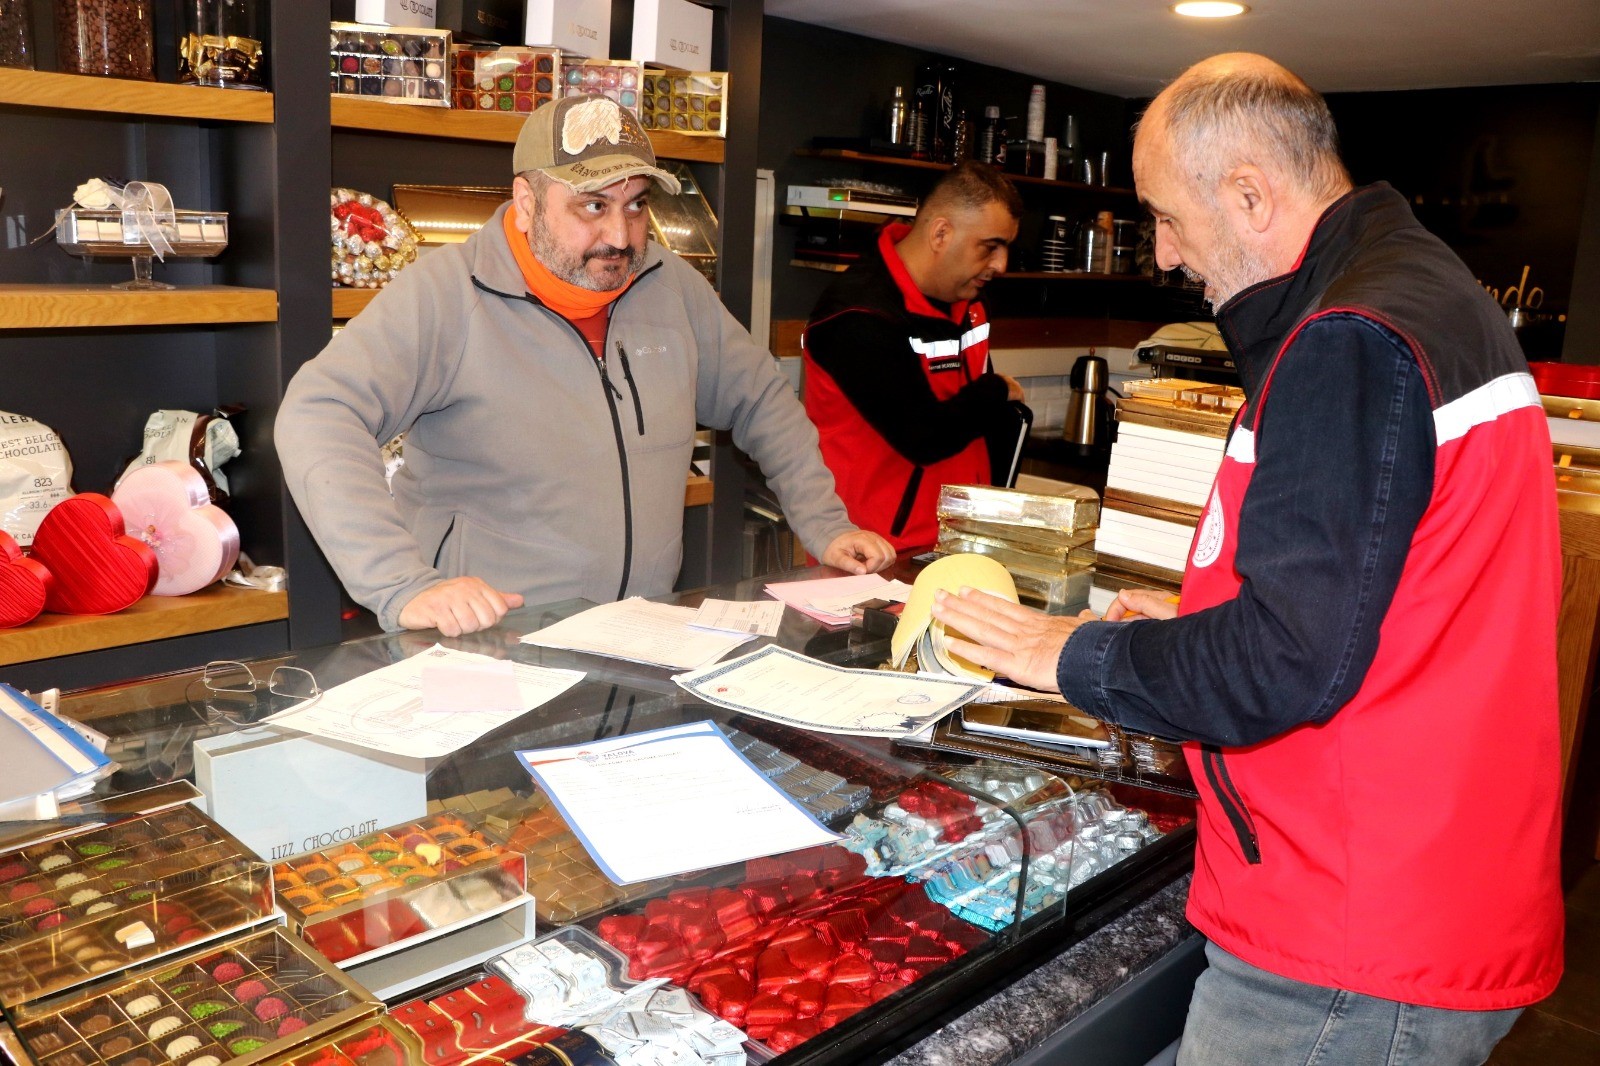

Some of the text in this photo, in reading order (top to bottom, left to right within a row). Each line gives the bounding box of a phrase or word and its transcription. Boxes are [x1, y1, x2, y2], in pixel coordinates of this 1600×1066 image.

[34, 478, 53, 488] 823
[29, 501, 48, 510] 33.6
[303, 819, 379, 852] CHOCOLATE
